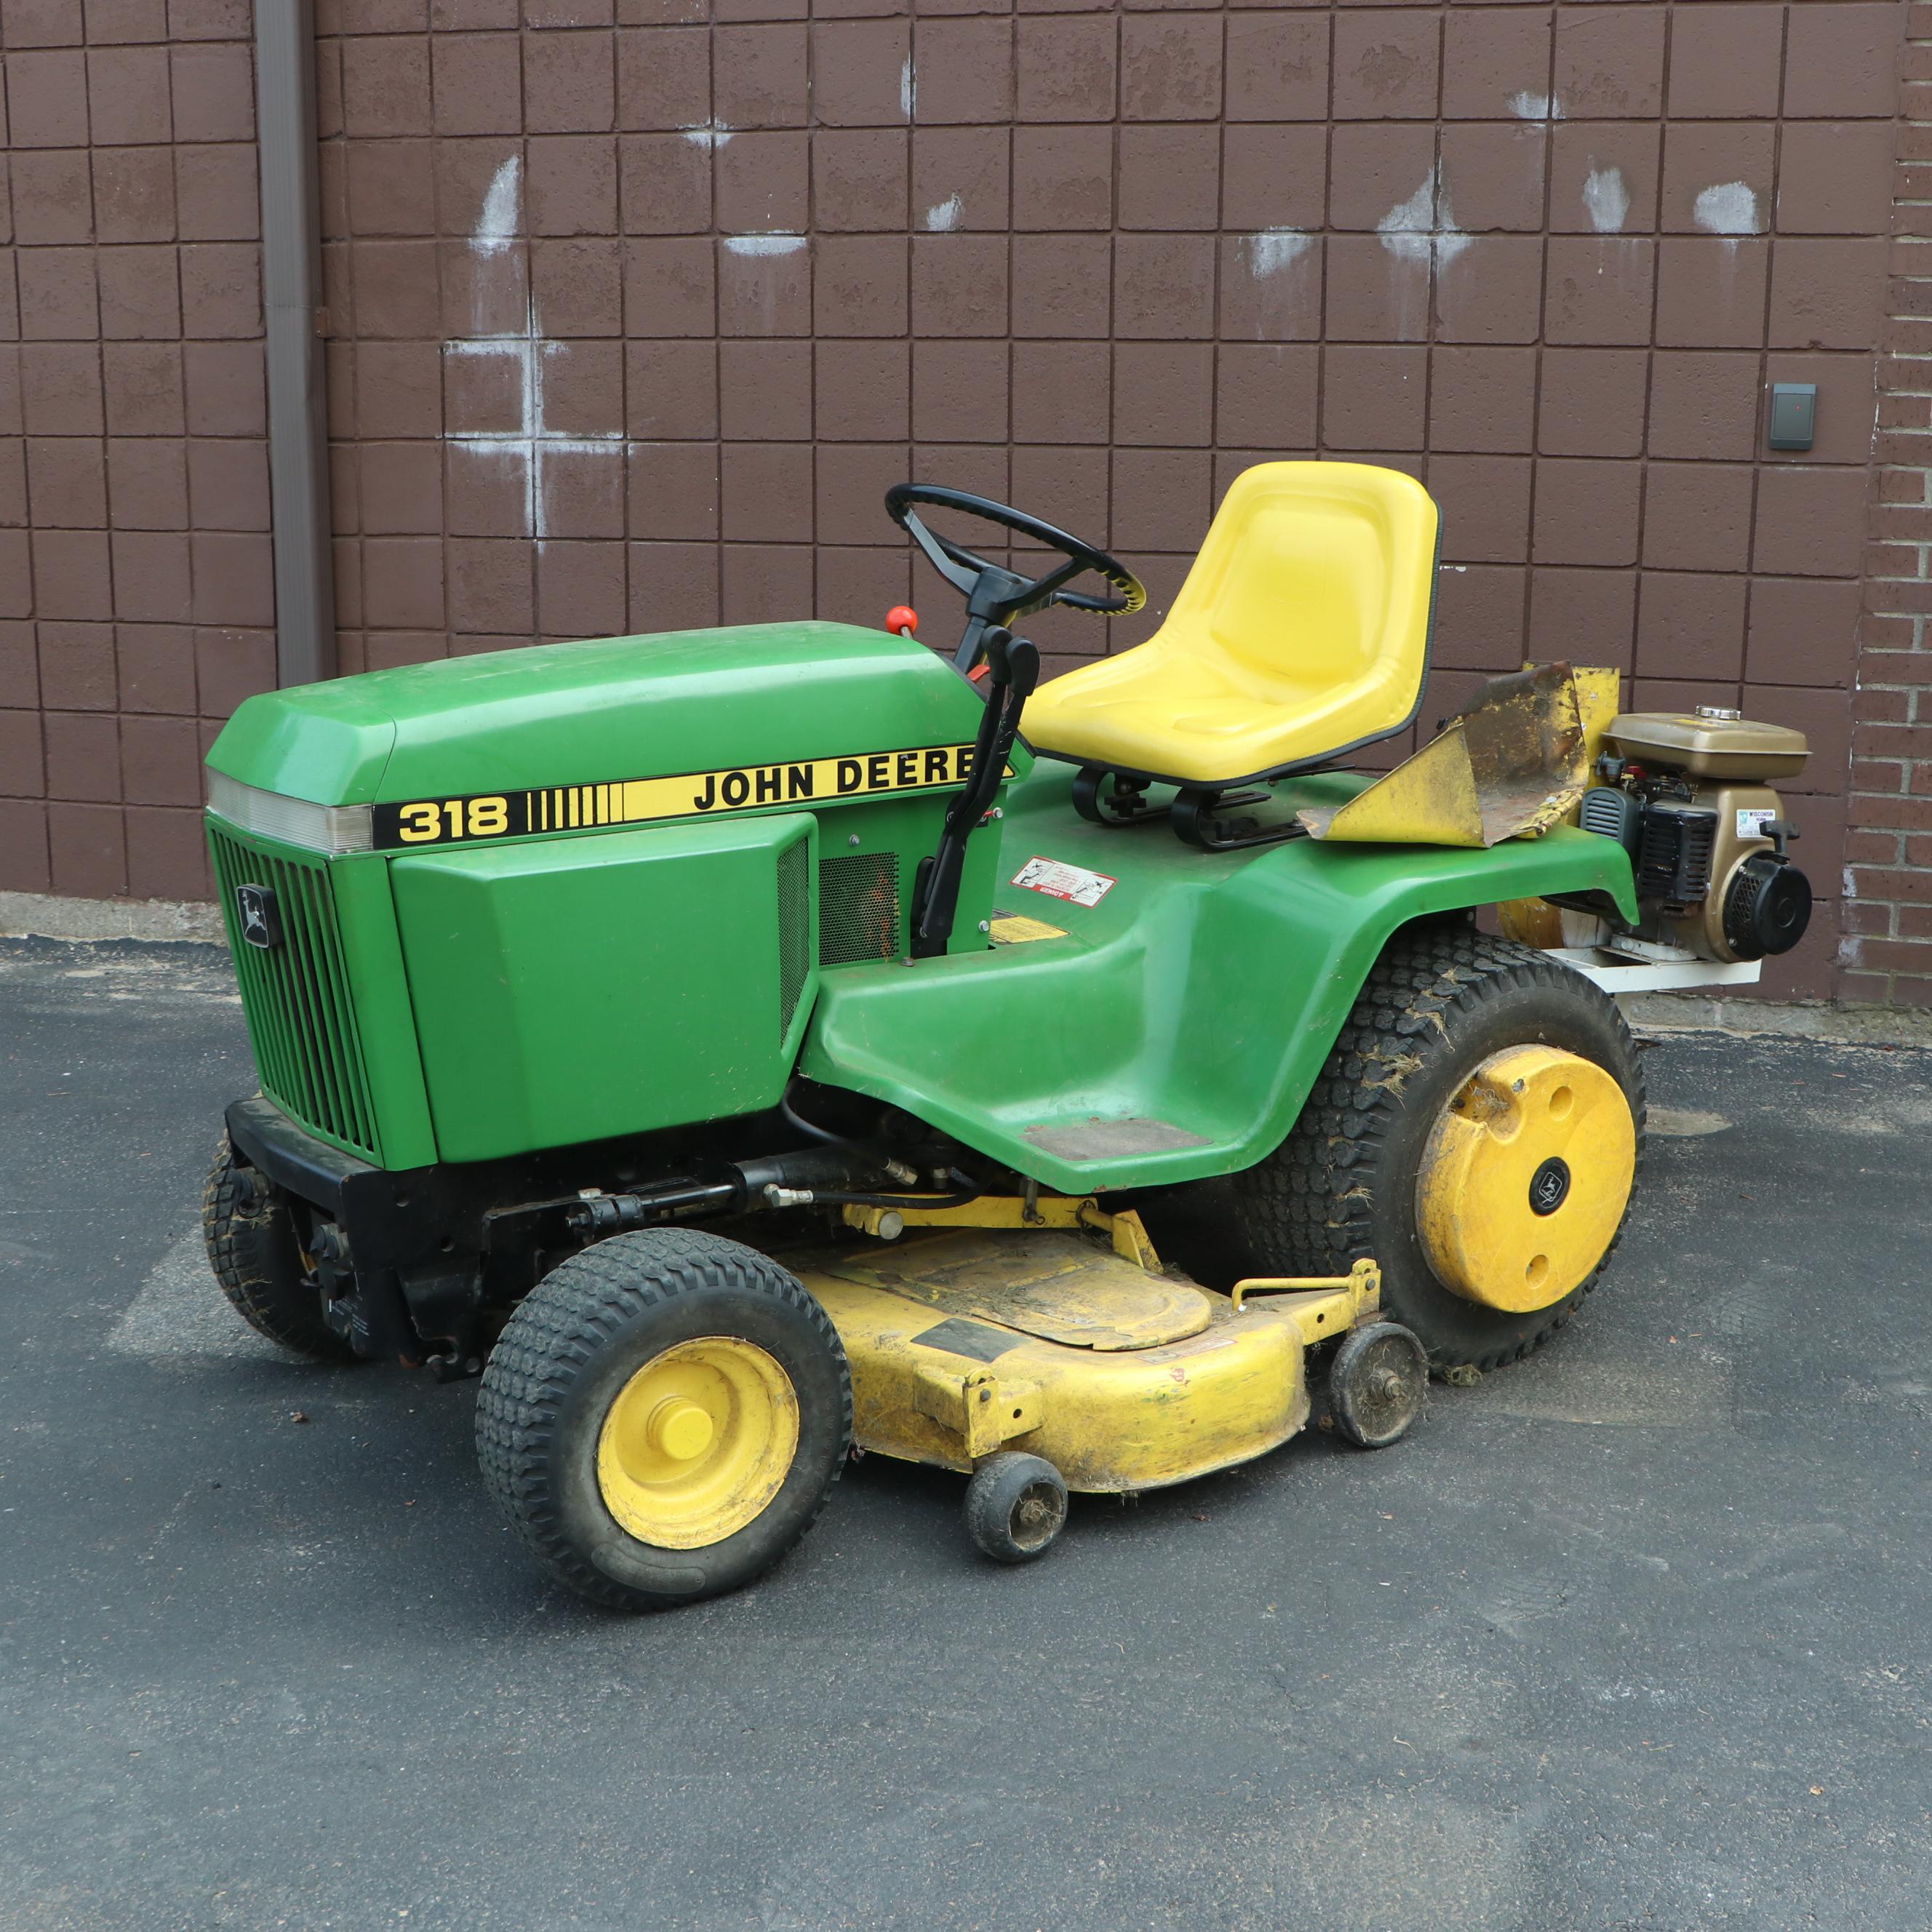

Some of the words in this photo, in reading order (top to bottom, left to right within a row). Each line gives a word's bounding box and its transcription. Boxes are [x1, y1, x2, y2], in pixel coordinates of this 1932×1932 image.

[694, 765, 813, 810] JOHN
[837, 748, 974, 792] DEERE
[399, 797, 508, 842] 318
[1039, 887, 1060, 896] DANGER
